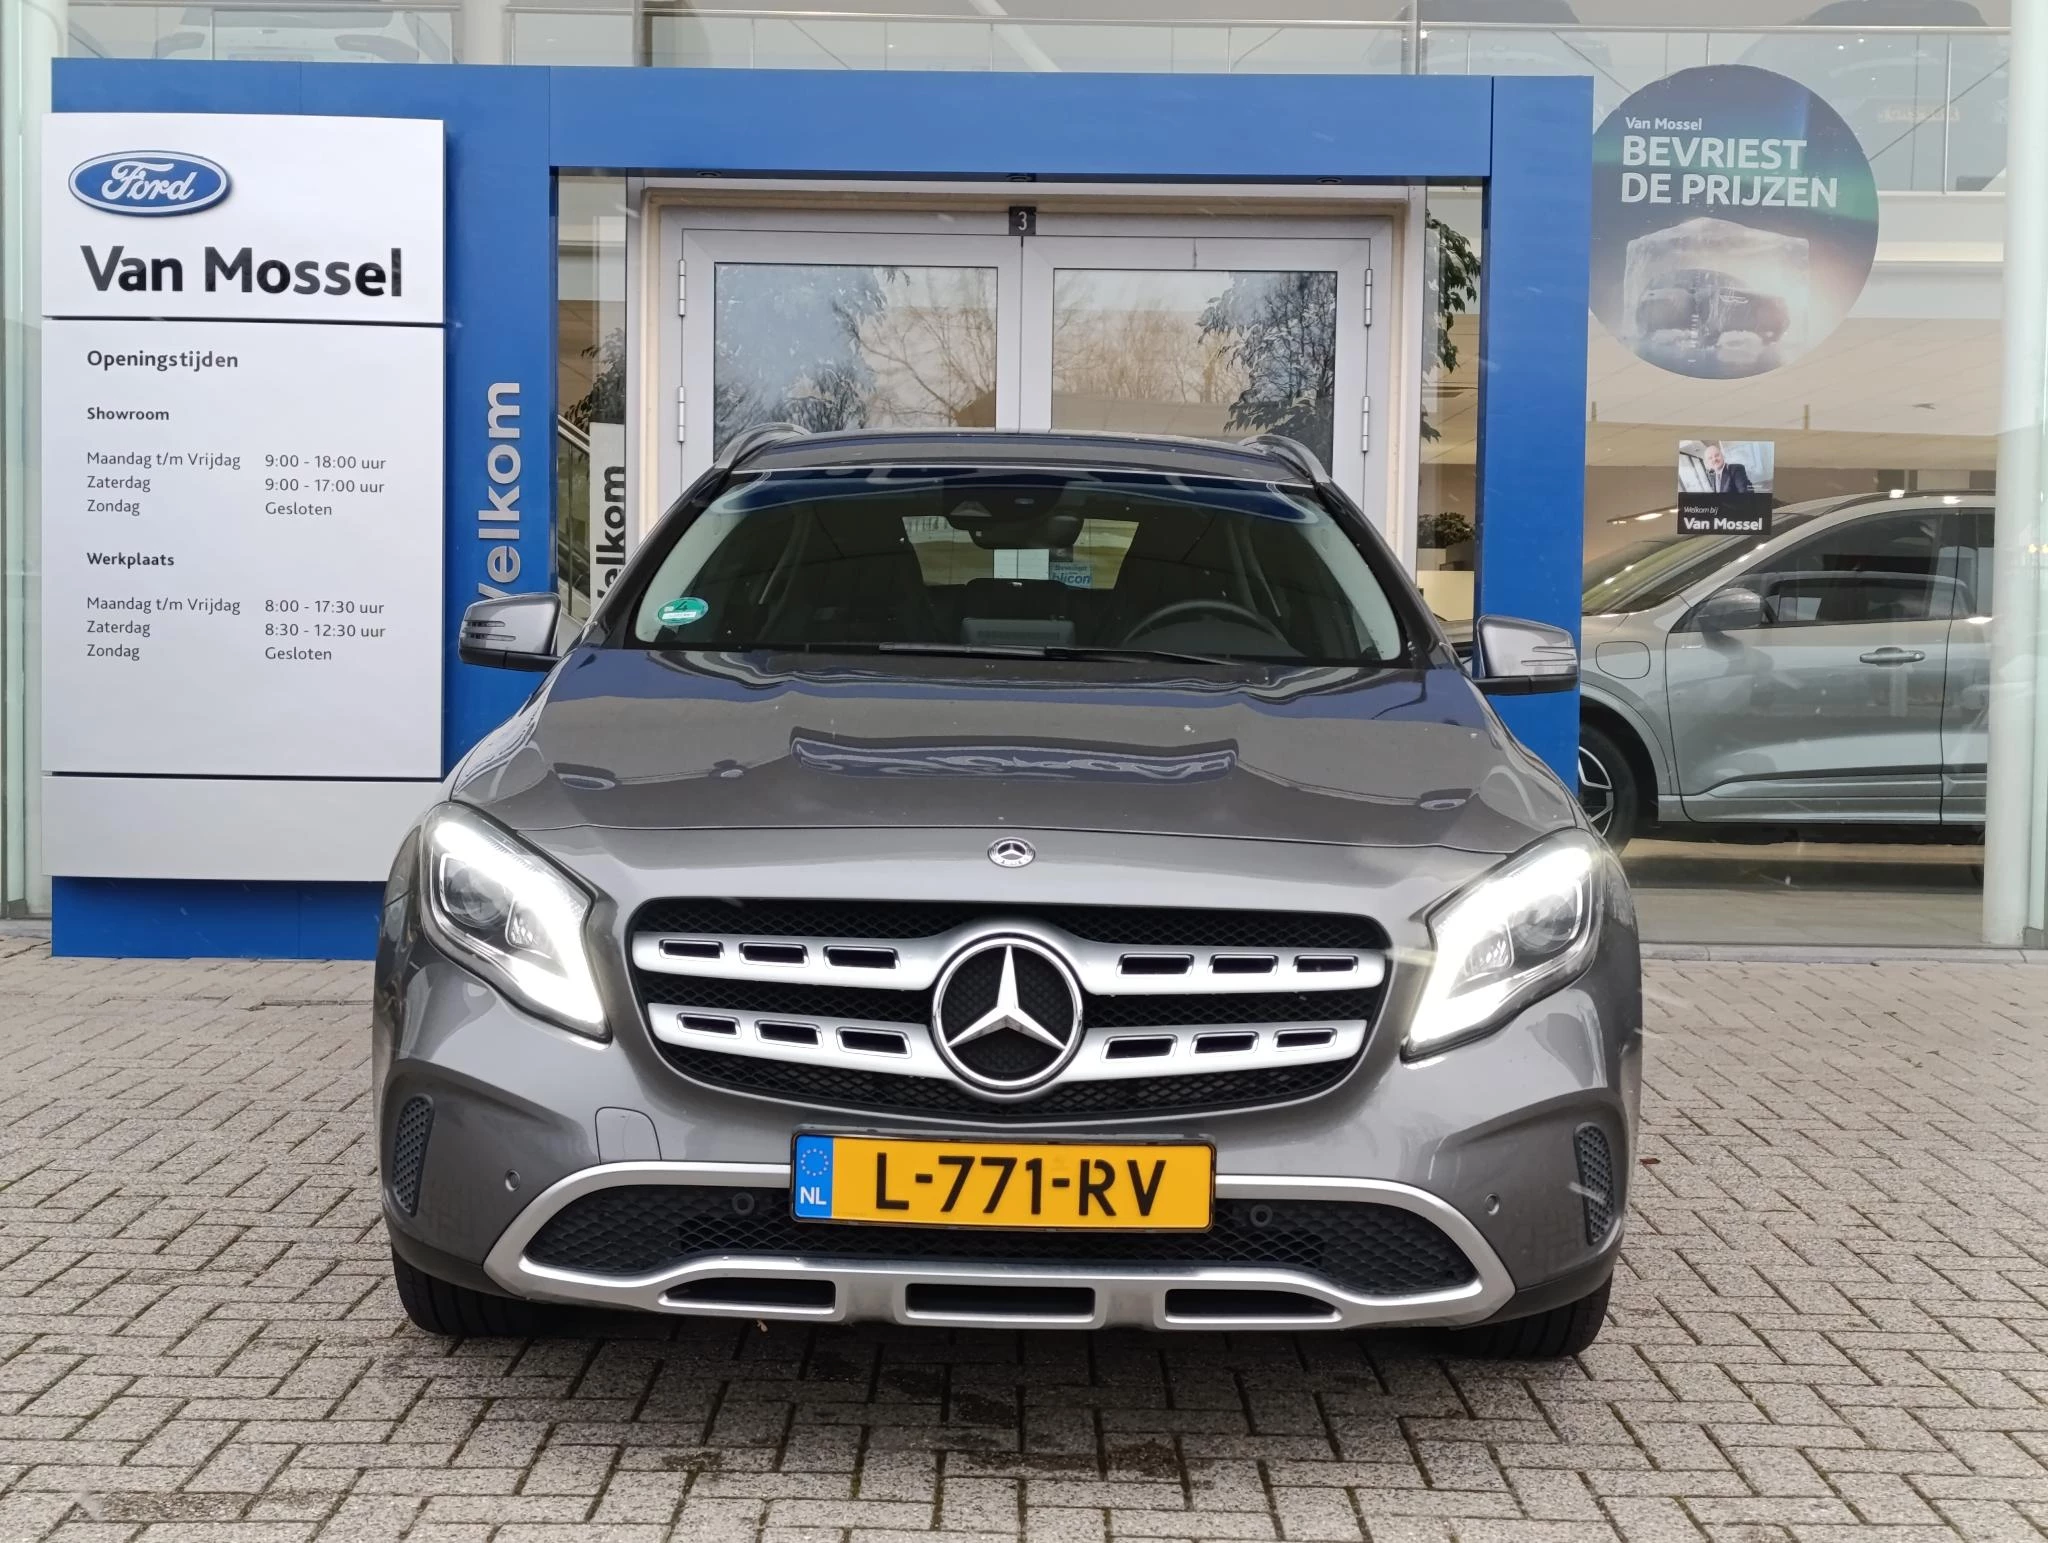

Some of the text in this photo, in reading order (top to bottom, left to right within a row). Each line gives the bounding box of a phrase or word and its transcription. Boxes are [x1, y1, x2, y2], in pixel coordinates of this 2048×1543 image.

[1625, 116, 1703, 131] Van Mossel
[1623, 136, 1807, 170] BEVRIEST
[101, 160, 198, 201] Ford
[1621, 172, 1838, 208] DE PRIJZEN
[1018, 211, 1028, 231] 3
[80, 245, 402, 297] Van Mossel
[87, 349, 238, 373] Openingstijden
[87, 406, 170, 421] Showroom
[88, 452, 152, 470] Maandag
[155, 451, 183, 466] t/m
[187, 452, 241, 471] Vrijdag
[265, 454, 299, 468] 9:00
[314, 455, 357, 469] 18:00
[361, 459, 387, 470] uur
[87, 476, 151, 494] Zaterdag
[265, 478, 299, 492] 9:00
[314, 479, 355, 493] 17:00
[359, 483, 385, 494] uur
[478, 382, 521, 599] elkom
[87, 498, 332, 517] Zondag Gesloten
[1684, 506, 1719, 516] Welkom bij
[596, 466, 625, 598] elkom
[1683, 517, 1763, 531] Van Mossel
[86, 551, 175, 570] Werkplaats
[87, 597, 152, 615] Maandag
[155, 597, 183, 611] t/m
[187, 597, 241, 616] Vrijdag
[264, 599, 300, 613] 8:00
[314, 600, 355, 614] 17:30
[359, 604, 385, 614] uur
[87, 620, 151, 639] Zaterdag
[265, 623, 299, 637] 8:30
[314, 623, 356, 637] 12:30
[360, 627, 386, 638] uur
[86, 643, 332, 662] Zondag Gesloten
[875, 1153, 1167, 1216] L-771-RV
[800, 1186, 827, 1206] NL
